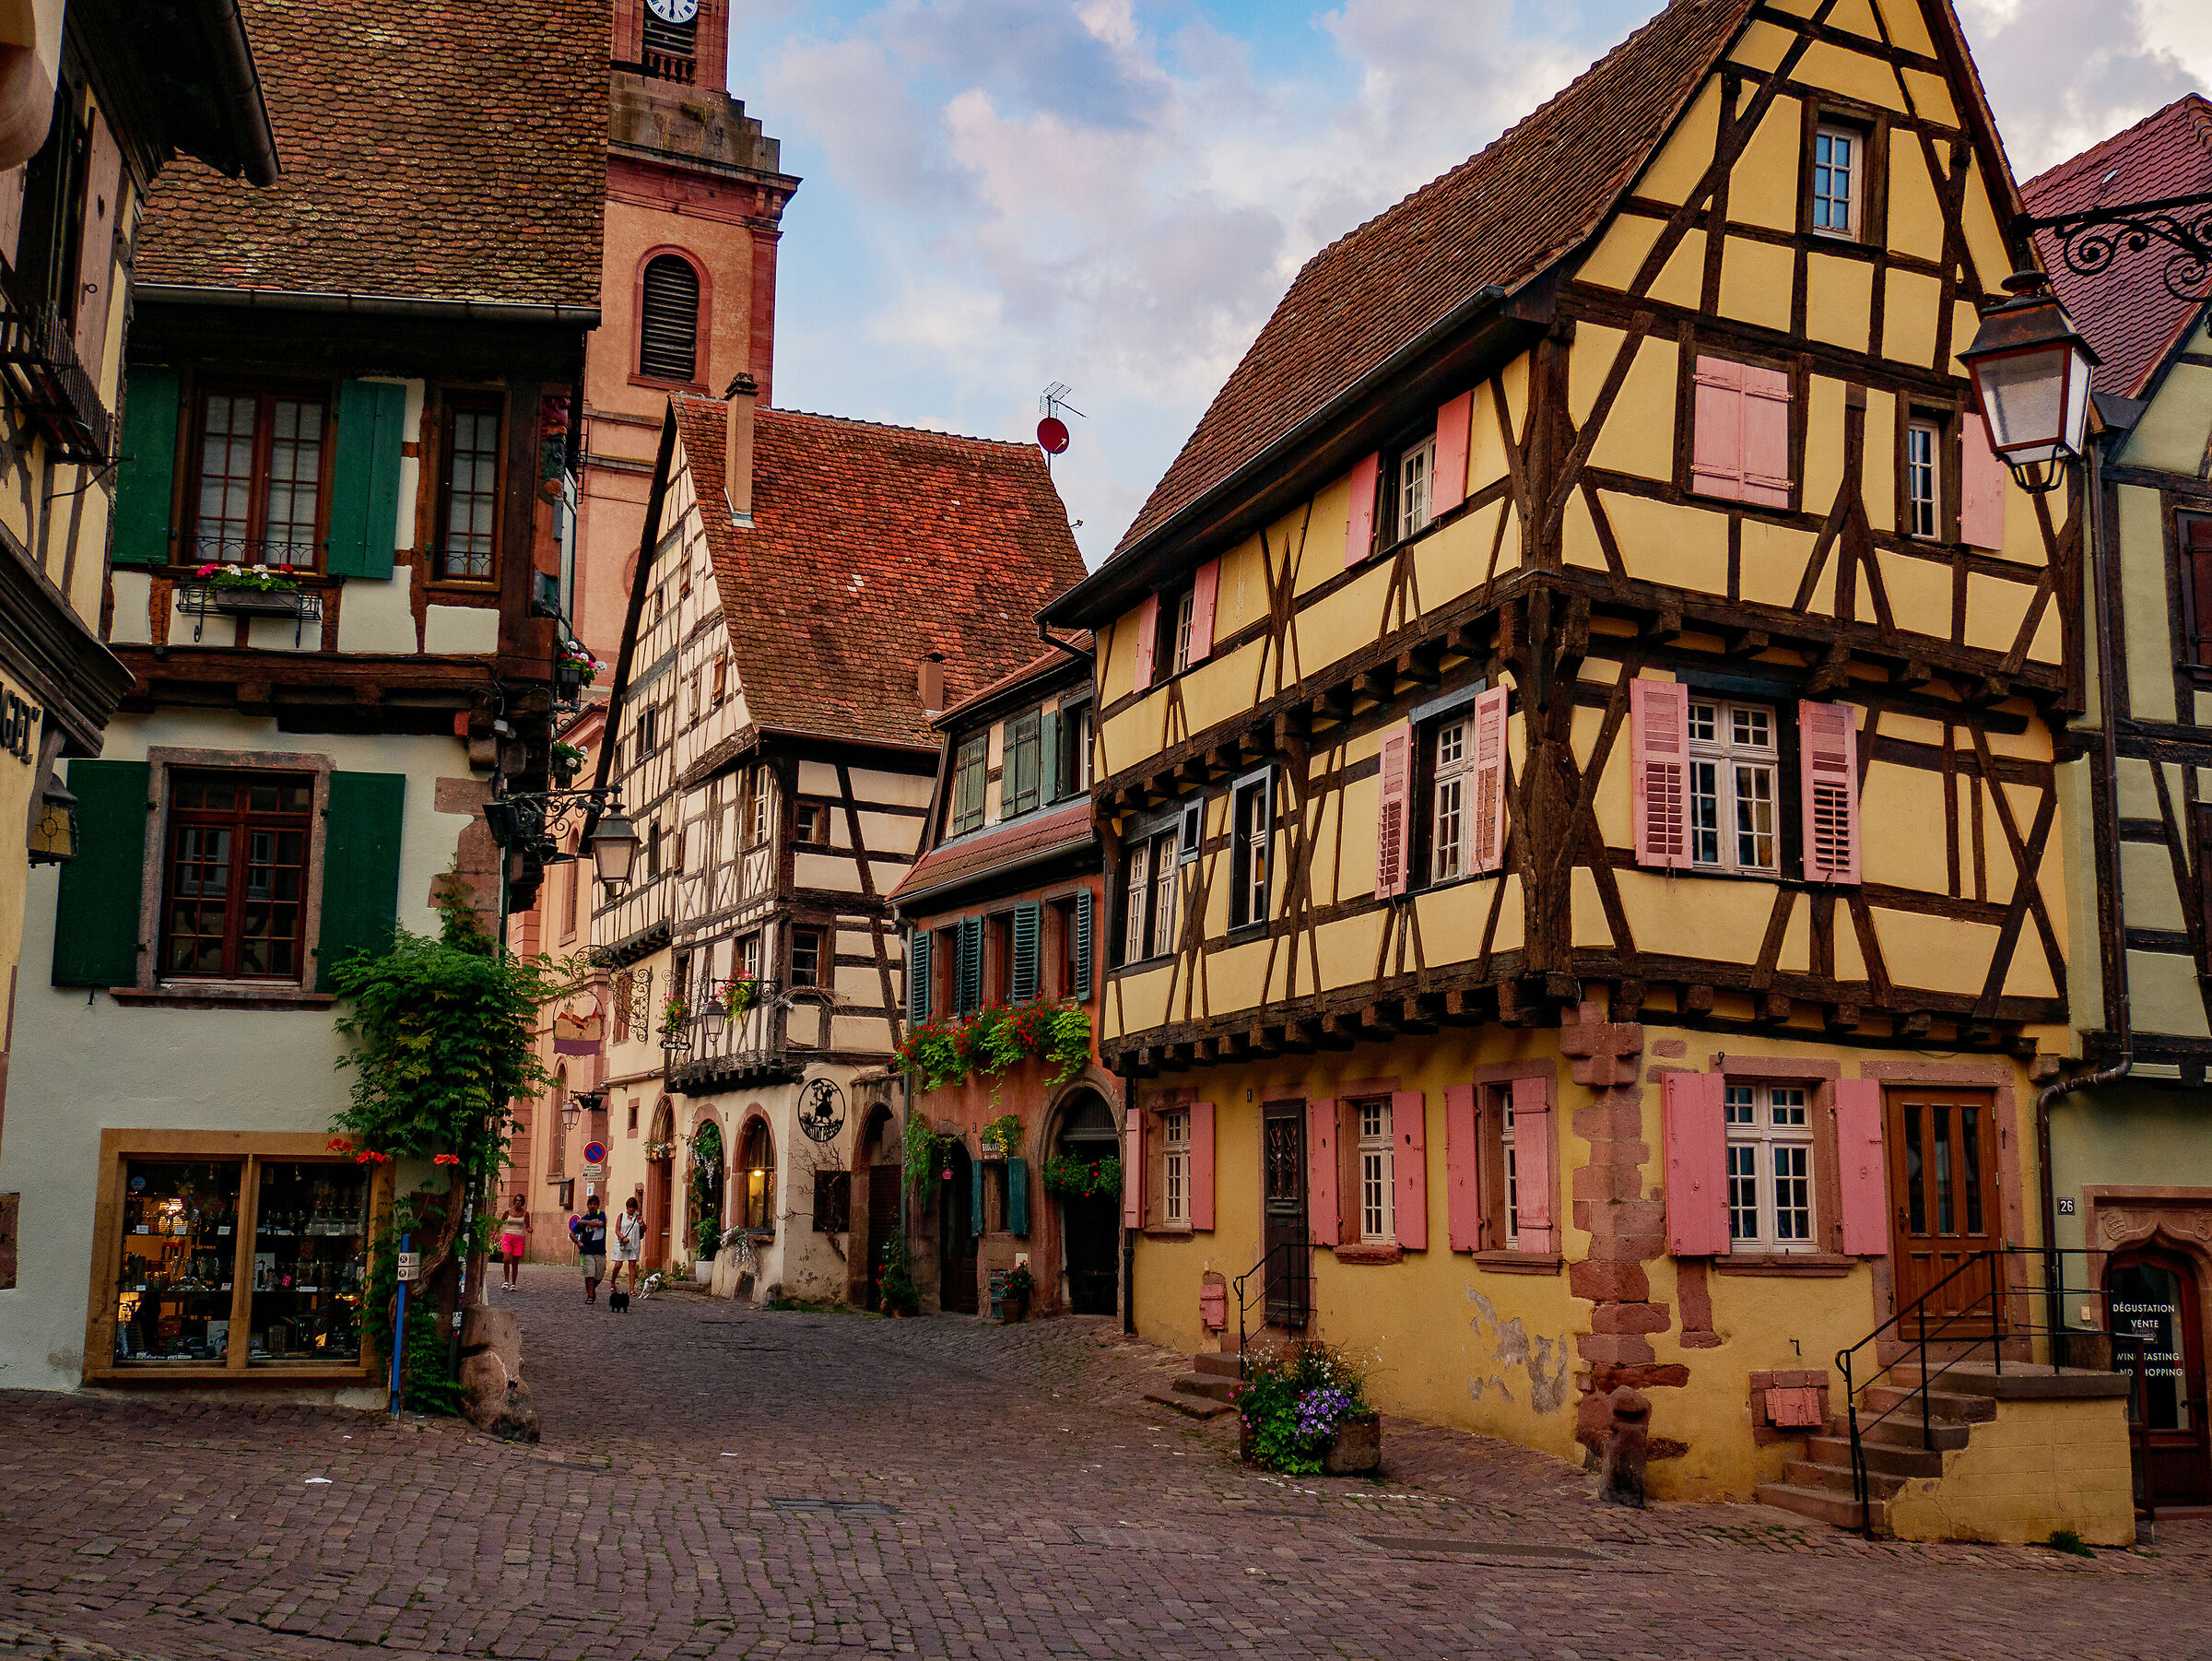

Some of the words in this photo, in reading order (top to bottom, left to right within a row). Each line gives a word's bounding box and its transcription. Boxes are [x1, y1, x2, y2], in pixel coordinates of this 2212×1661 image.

[2060, 1200, 2074, 1212] 26
[2112, 1302, 2175, 1313] DÉGUSTATION
[2130, 1319, 2159, 1328] VENTE
[2116, 1352, 2136, 1361] WIN
[2145, 1368, 2183, 1377] OPPING
